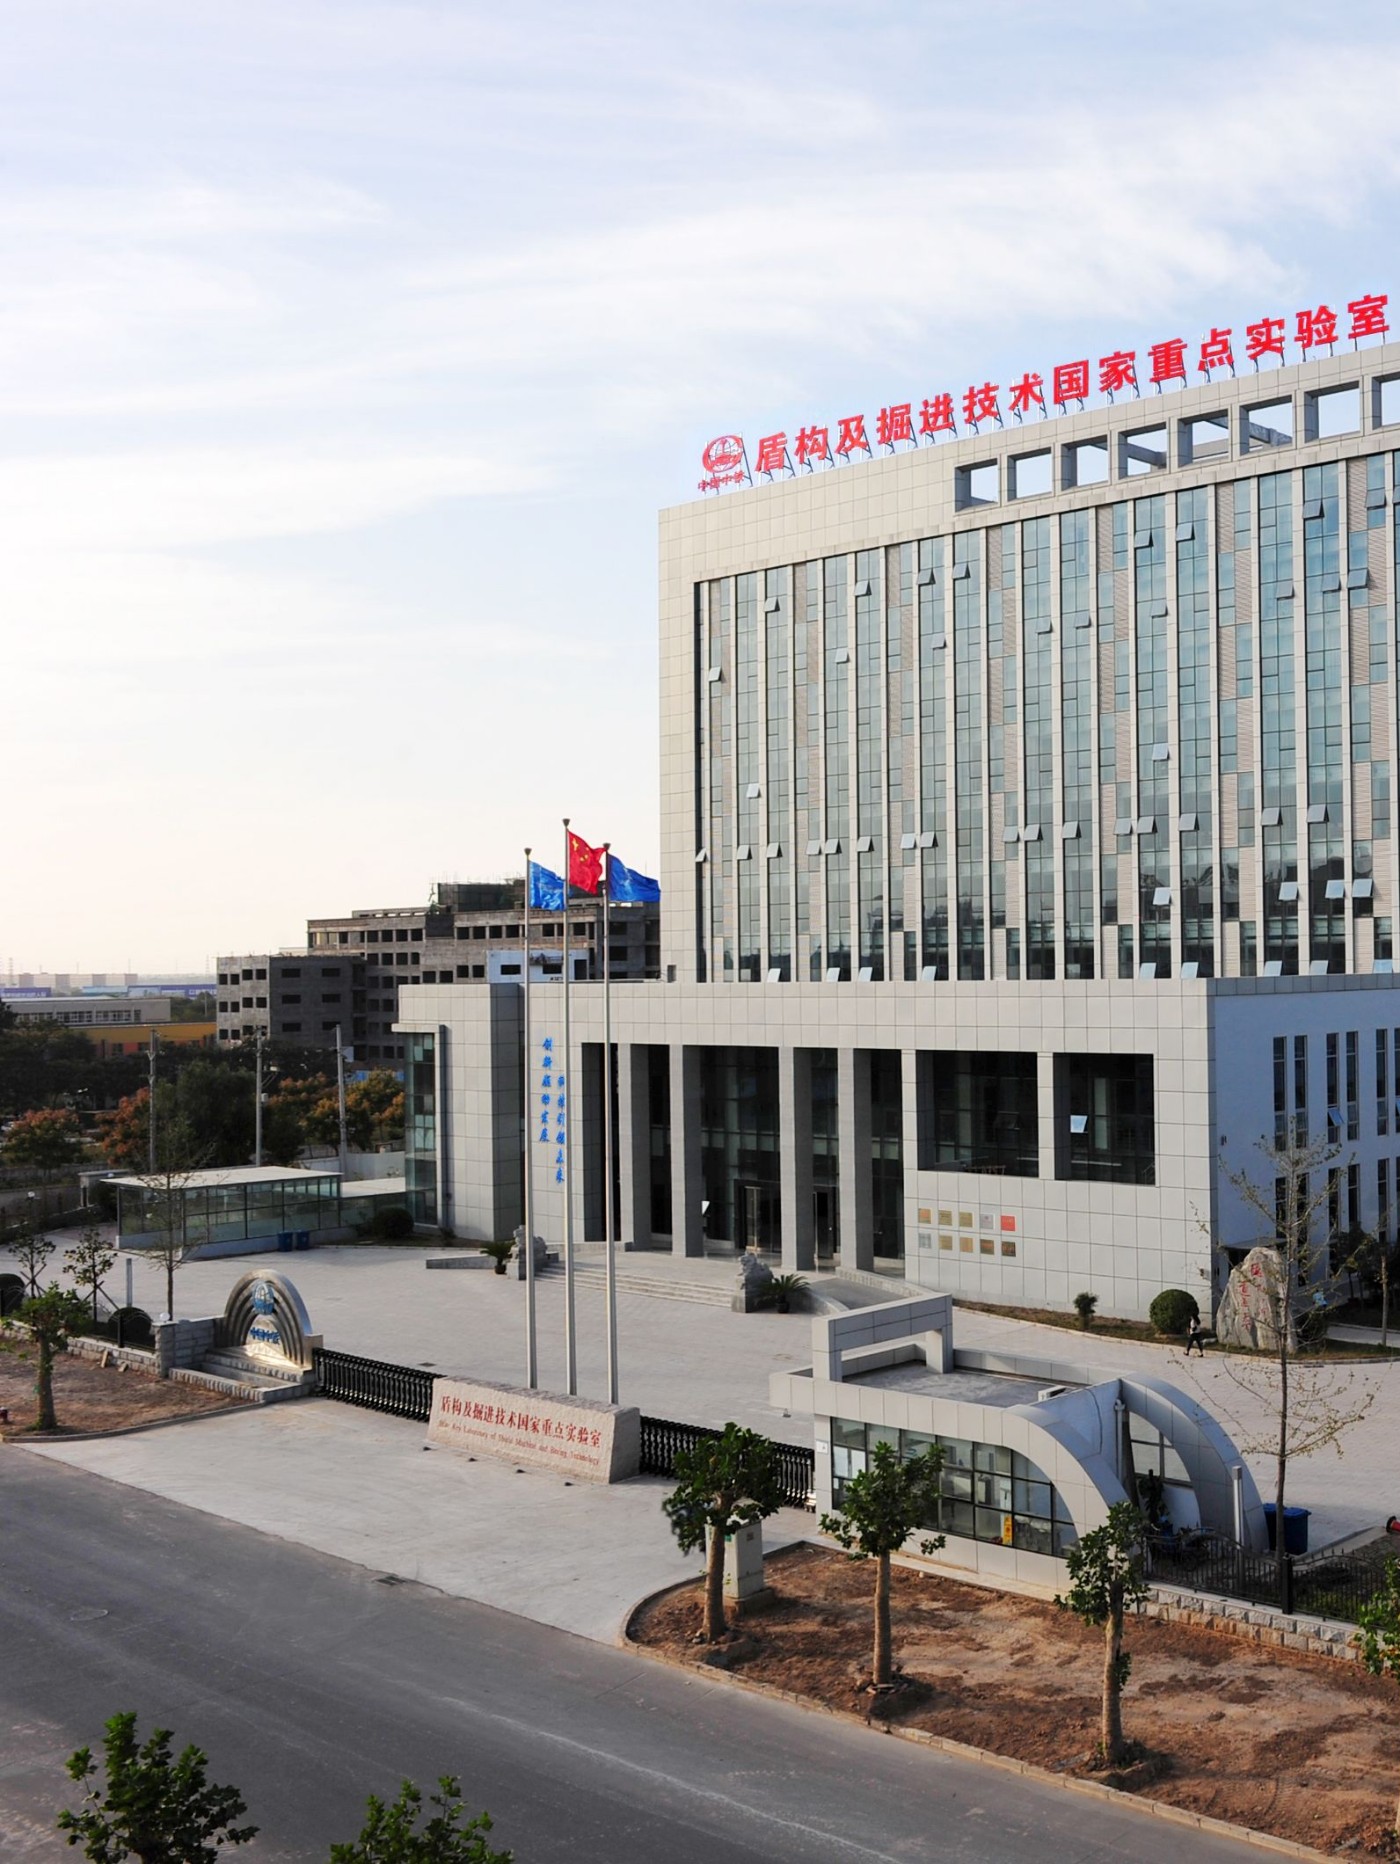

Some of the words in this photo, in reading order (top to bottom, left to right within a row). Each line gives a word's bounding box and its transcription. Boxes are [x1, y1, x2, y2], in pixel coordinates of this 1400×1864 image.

[756, 294, 1390, 474] 盾构及掘进技术国家重点实验室
[698, 470, 744, 491] 中国中铁
[441, 1395, 601, 1448] 盾构及掘进技术国家重点实验室
